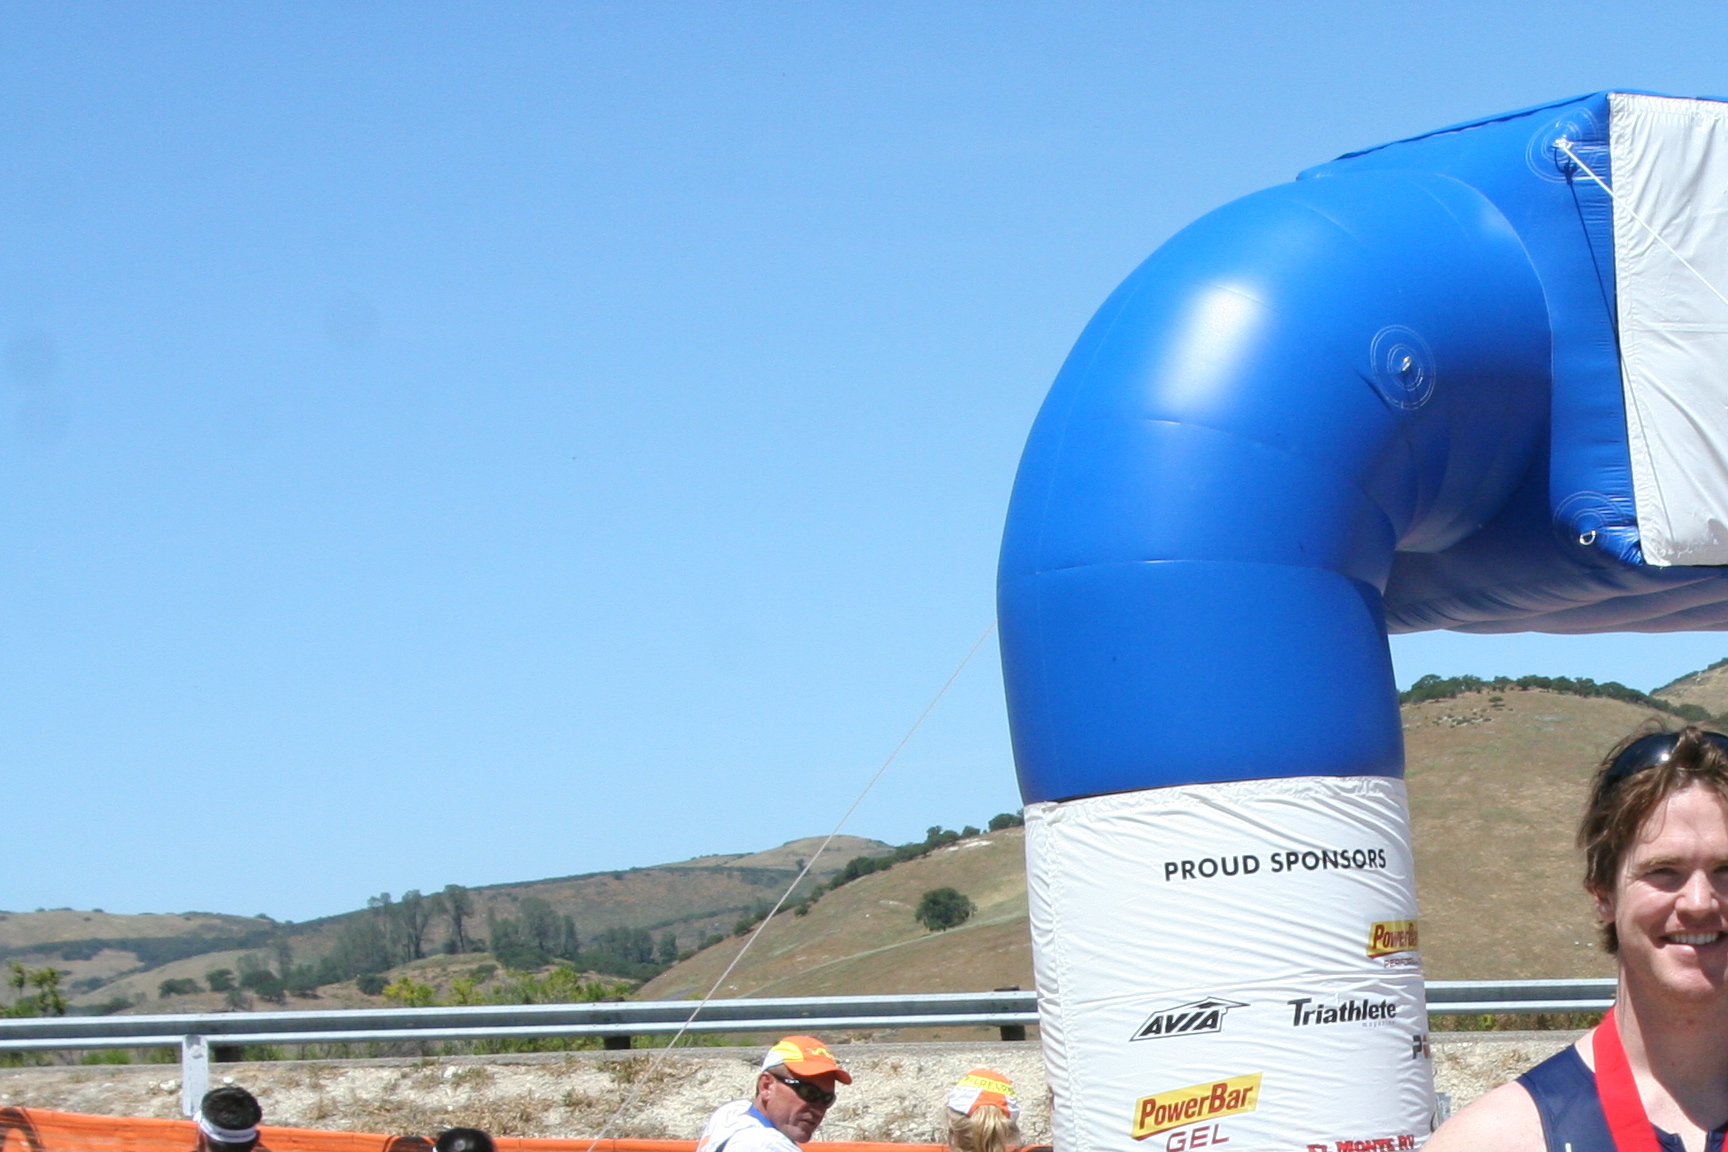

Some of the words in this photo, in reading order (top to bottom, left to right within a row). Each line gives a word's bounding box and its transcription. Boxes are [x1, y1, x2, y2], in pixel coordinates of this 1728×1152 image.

[1164, 853, 1260, 882] PROUD
[1270, 848, 1387, 874] SPONSORS
[1141, 1007, 1223, 1036] AVIA
[1287, 997, 1398, 1027] Triathlete
[1139, 1081, 1254, 1131] PowerBar
